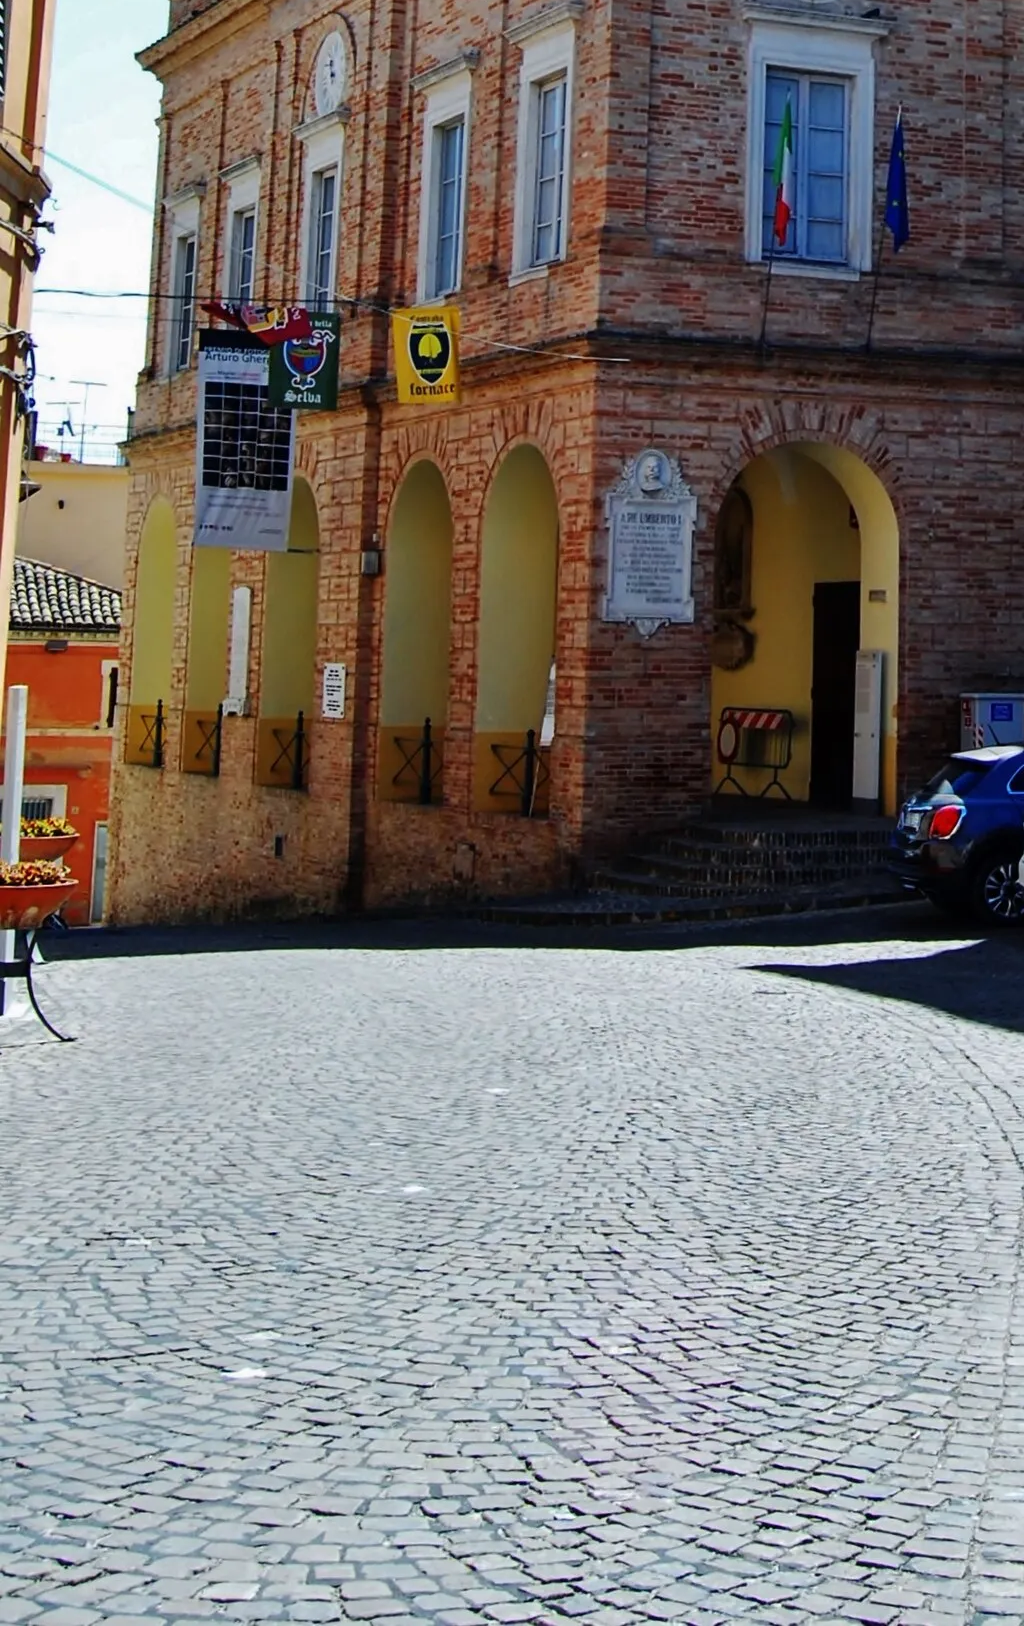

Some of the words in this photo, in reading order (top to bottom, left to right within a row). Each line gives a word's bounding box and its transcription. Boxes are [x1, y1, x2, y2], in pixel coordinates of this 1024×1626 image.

[205, 350, 239, 363] Arturo
[242, 354, 271, 365] Gher
[284, 390, 321, 403] Selva
[640, 512, 677, 525] UMBERTO
